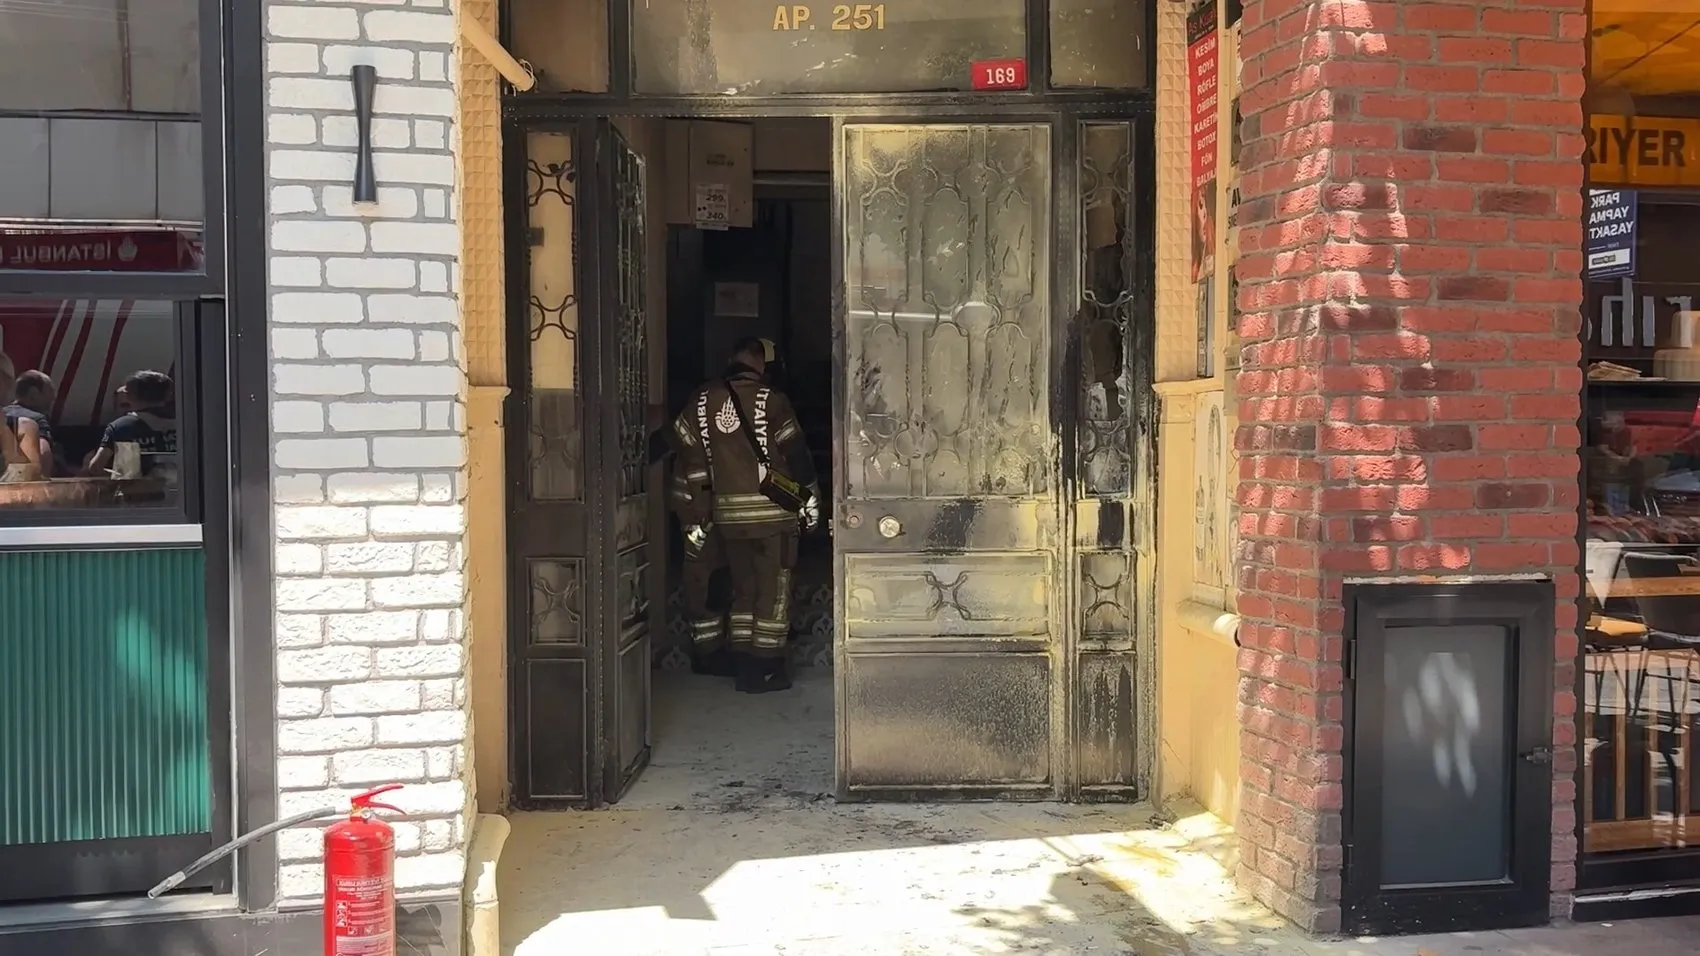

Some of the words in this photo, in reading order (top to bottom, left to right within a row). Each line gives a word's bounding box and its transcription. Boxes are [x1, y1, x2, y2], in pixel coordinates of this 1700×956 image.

[772, 5, 816, 30] AP.
[831, 4, 886, 30] 251
[1195, 37, 1216, 59] KESİM
[985, 67, 1016, 85] 169
[1198, 58, 1214, 76] BOYA
[1197, 131, 1217, 151] BOTOX
